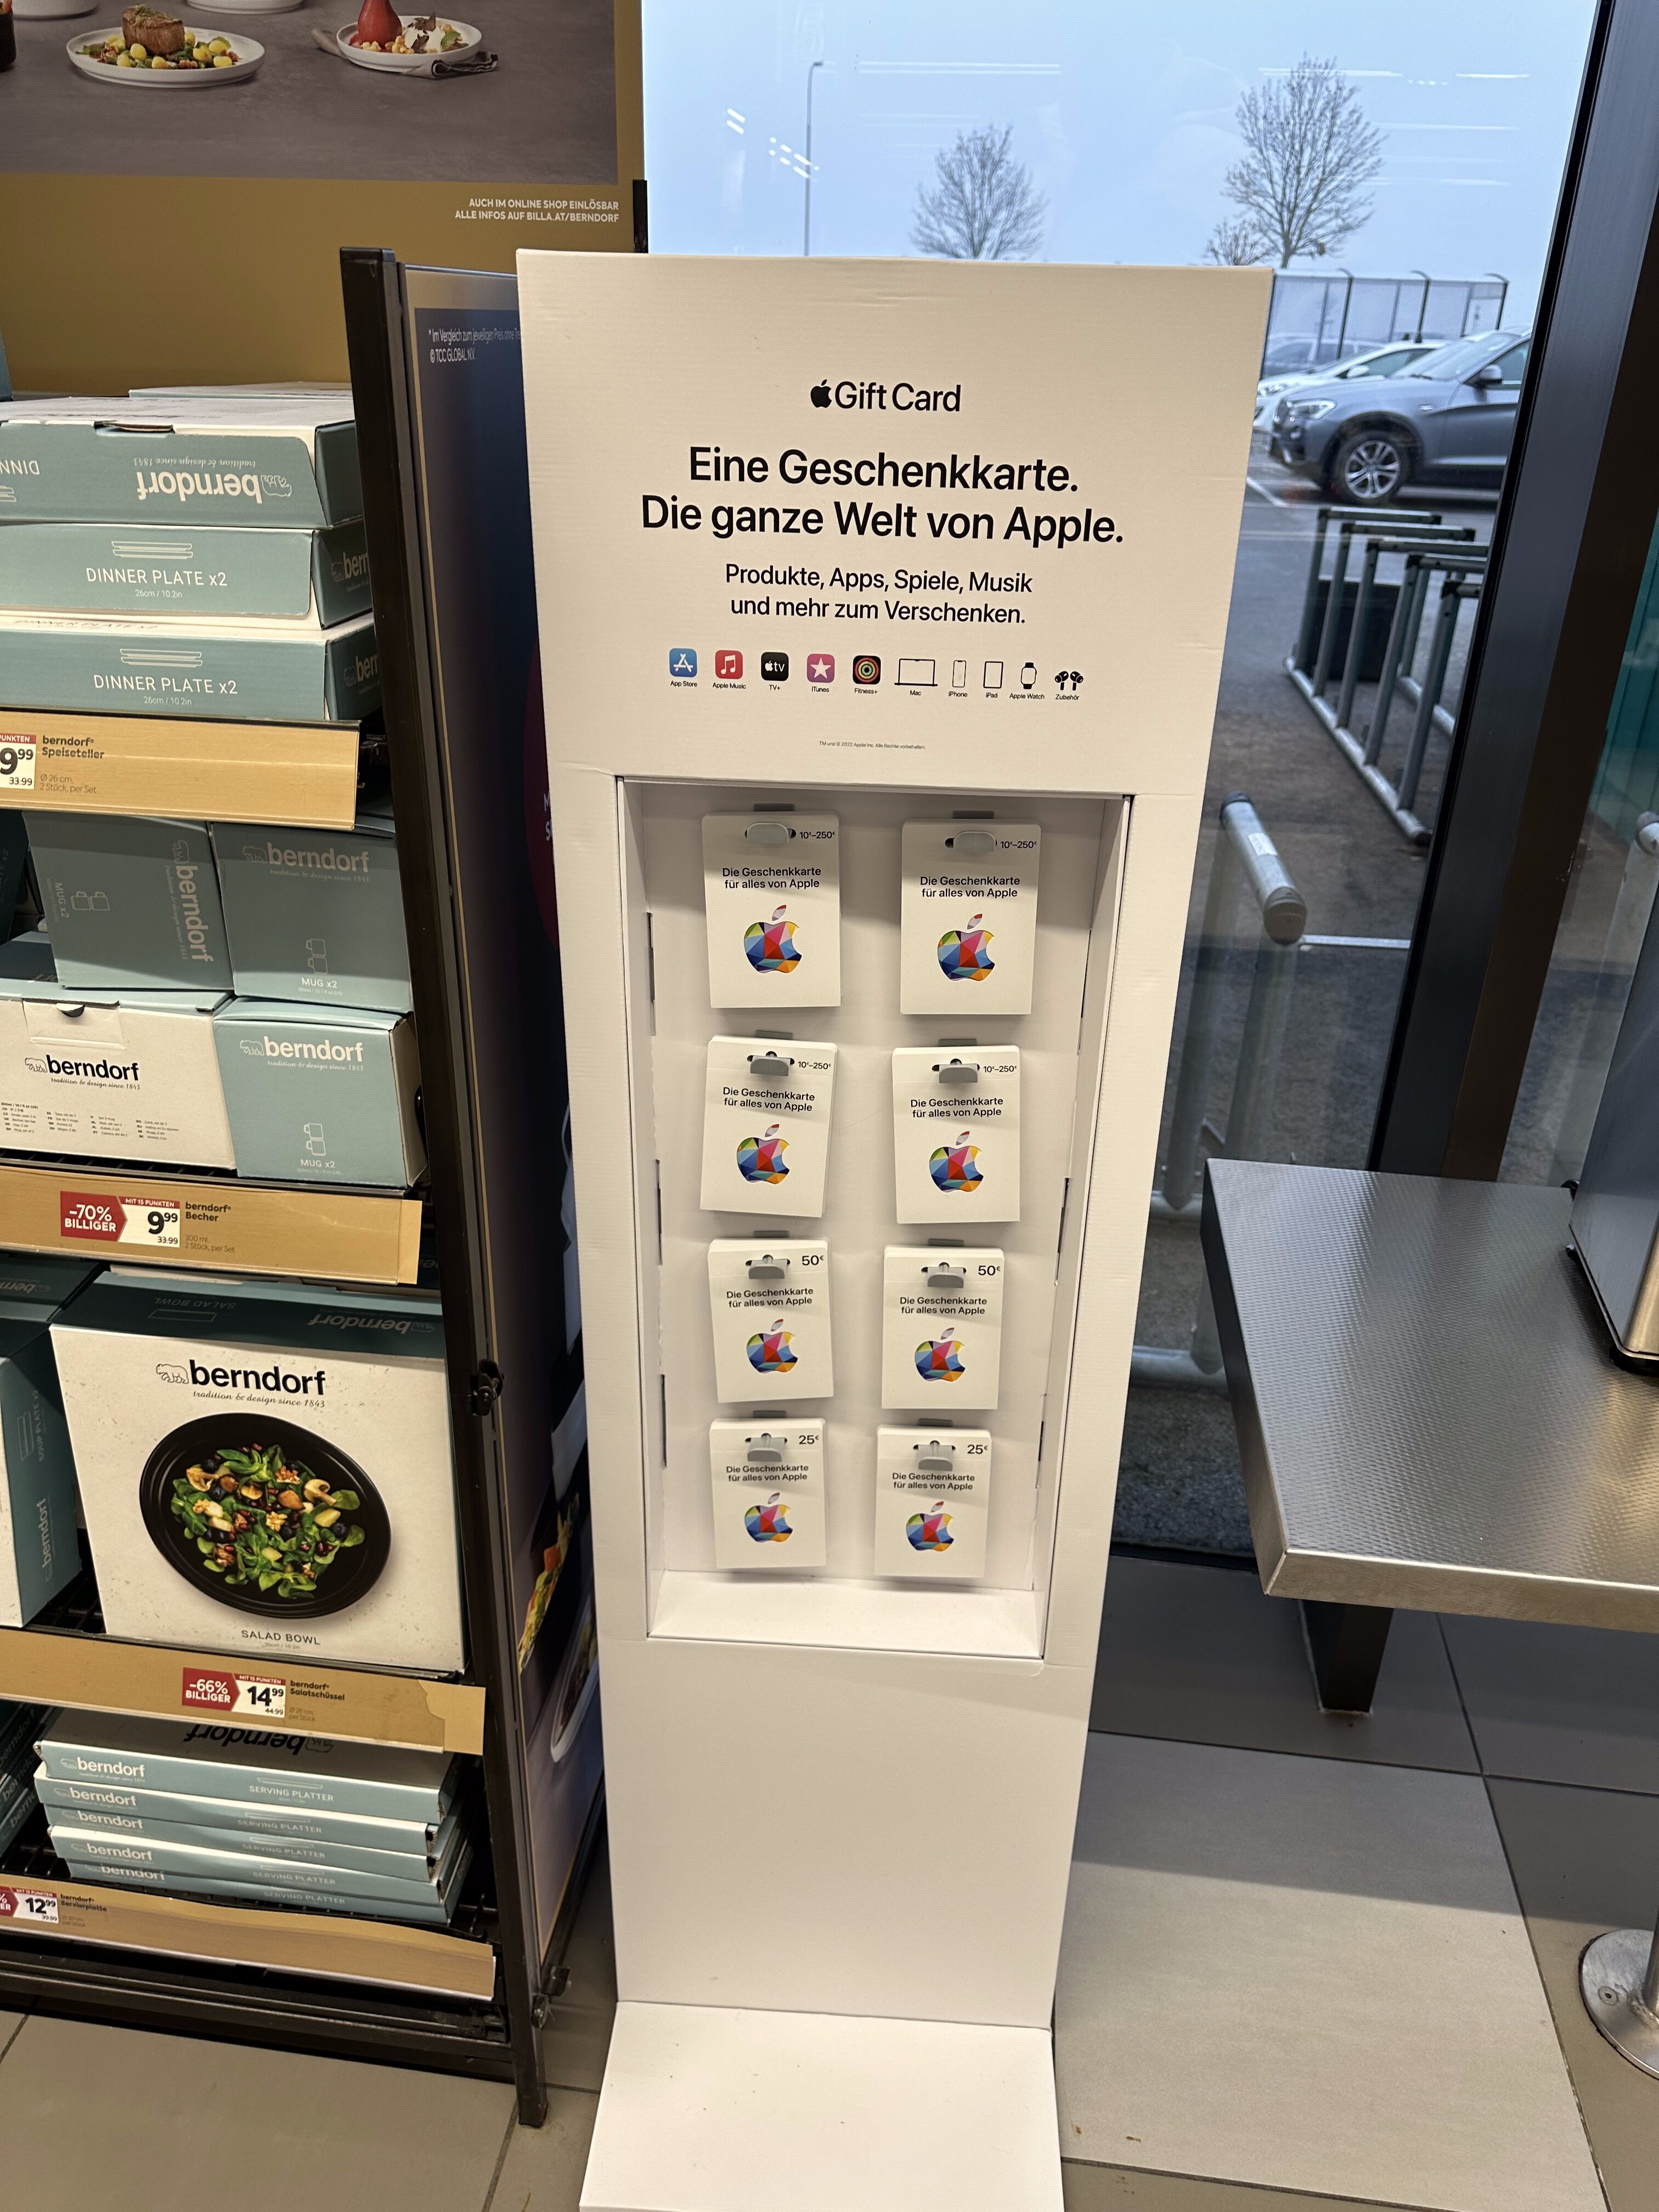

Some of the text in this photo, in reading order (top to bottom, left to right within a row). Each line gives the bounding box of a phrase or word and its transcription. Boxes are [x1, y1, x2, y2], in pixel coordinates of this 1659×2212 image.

[469, 199, 618, 210] AUCH IM ONLINE SHOP EINLÖSBAR
[455, 210, 619, 222] ALLE INFOS AUF BILLA.AT/BERNDORF
[436, 349, 447, 363] TCC
[447, 348, 467, 362] GLOBAL
[835, 381, 961, 411] Gift Card
[690, 447, 1077, 490] Eine Geschenkkarte.
[136, 472, 262, 504] berndorf
[642, 495, 1122, 548] Die ganze Welt von Apple.
[87, 568, 228, 586] DINNER PLATE x2
[726, 563, 1032, 594] Produkte, Apps, Spiele, Musik
[136, 589, 155, 597] 26cm
[731, 596, 1025, 623] und mehr zum Verschenken.
[94, 675, 238, 694] DINNER PLATE x2
[144, 696, 163, 704] 26cm
[42, 747, 104, 759] Speiseteller
[9, 777, 32, 786] 33.99
[267, 843, 369, 872] berndorf
[722, 867, 821, 876] Die Geschenkkarte
[725, 879, 739, 888] für
[742, 879, 765, 888] alles
[789, 879, 820, 889] Apple
[920, 876, 1020, 885] Die Geschenkkarte
[922, 888, 936, 897] für
[939, 888, 962, 896] alles
[987, 888, 1017, 899] Apple
[176, 865, 214, 962] berndorf
[302, 978, 338, 988] MUG x2
[264, 1036, 363, 1062] berndorf
[46, 1054, 139, 1081] berndorf
[723, 1087, 815, 1101] Die Geschenkkarte
[724, 1097, 738, 1106] für
[740, 1099, 761, 1108] alles
[783, 1102, 812, 1112] Apple
[911, 1097, 1003, 1107] Die Geschenkkarte
[973, 1108, 1001, 1117] Apple
[69, 1204, 112, 1222] -70%
[186, 1212, 218, 1221] Becher
[65, 1218, 116, 1232] BILLIGER
[157, 1236, 178, 1244] 33.99
[743, 1288, 813, 1297] Geschenkkarte
[786, 1297, 812, 1306] Apple
[189, 1359, 326, 1395] berndorf
[194, 1390, 325, 1408] tradition & design since 1843
[947, 1482, 973, 1491] Apple
[241, 1630, 320, 1645] SALAD BOWL
[190, 1679, 228, 1695] -66%
[185, 1690, 230, 1703] BILLIGER
[290, 1689, 345, 1701] Salatschüssel
[77, 1757, 145, 1777] berndorf
[70, 1787, 137, 1806] berndorf
[250, 1785, 289, 1797] SERVING
[292, 1791, 334, 1802] PLATTER
[77, 1810, 143, 1829] berndorf
[237, 1820, 323, 1833] SERVING PLATTER
[87, 1843, 153, 1861] berndorf
[253, 1871, 336, 1885] SERVING PLATTER
